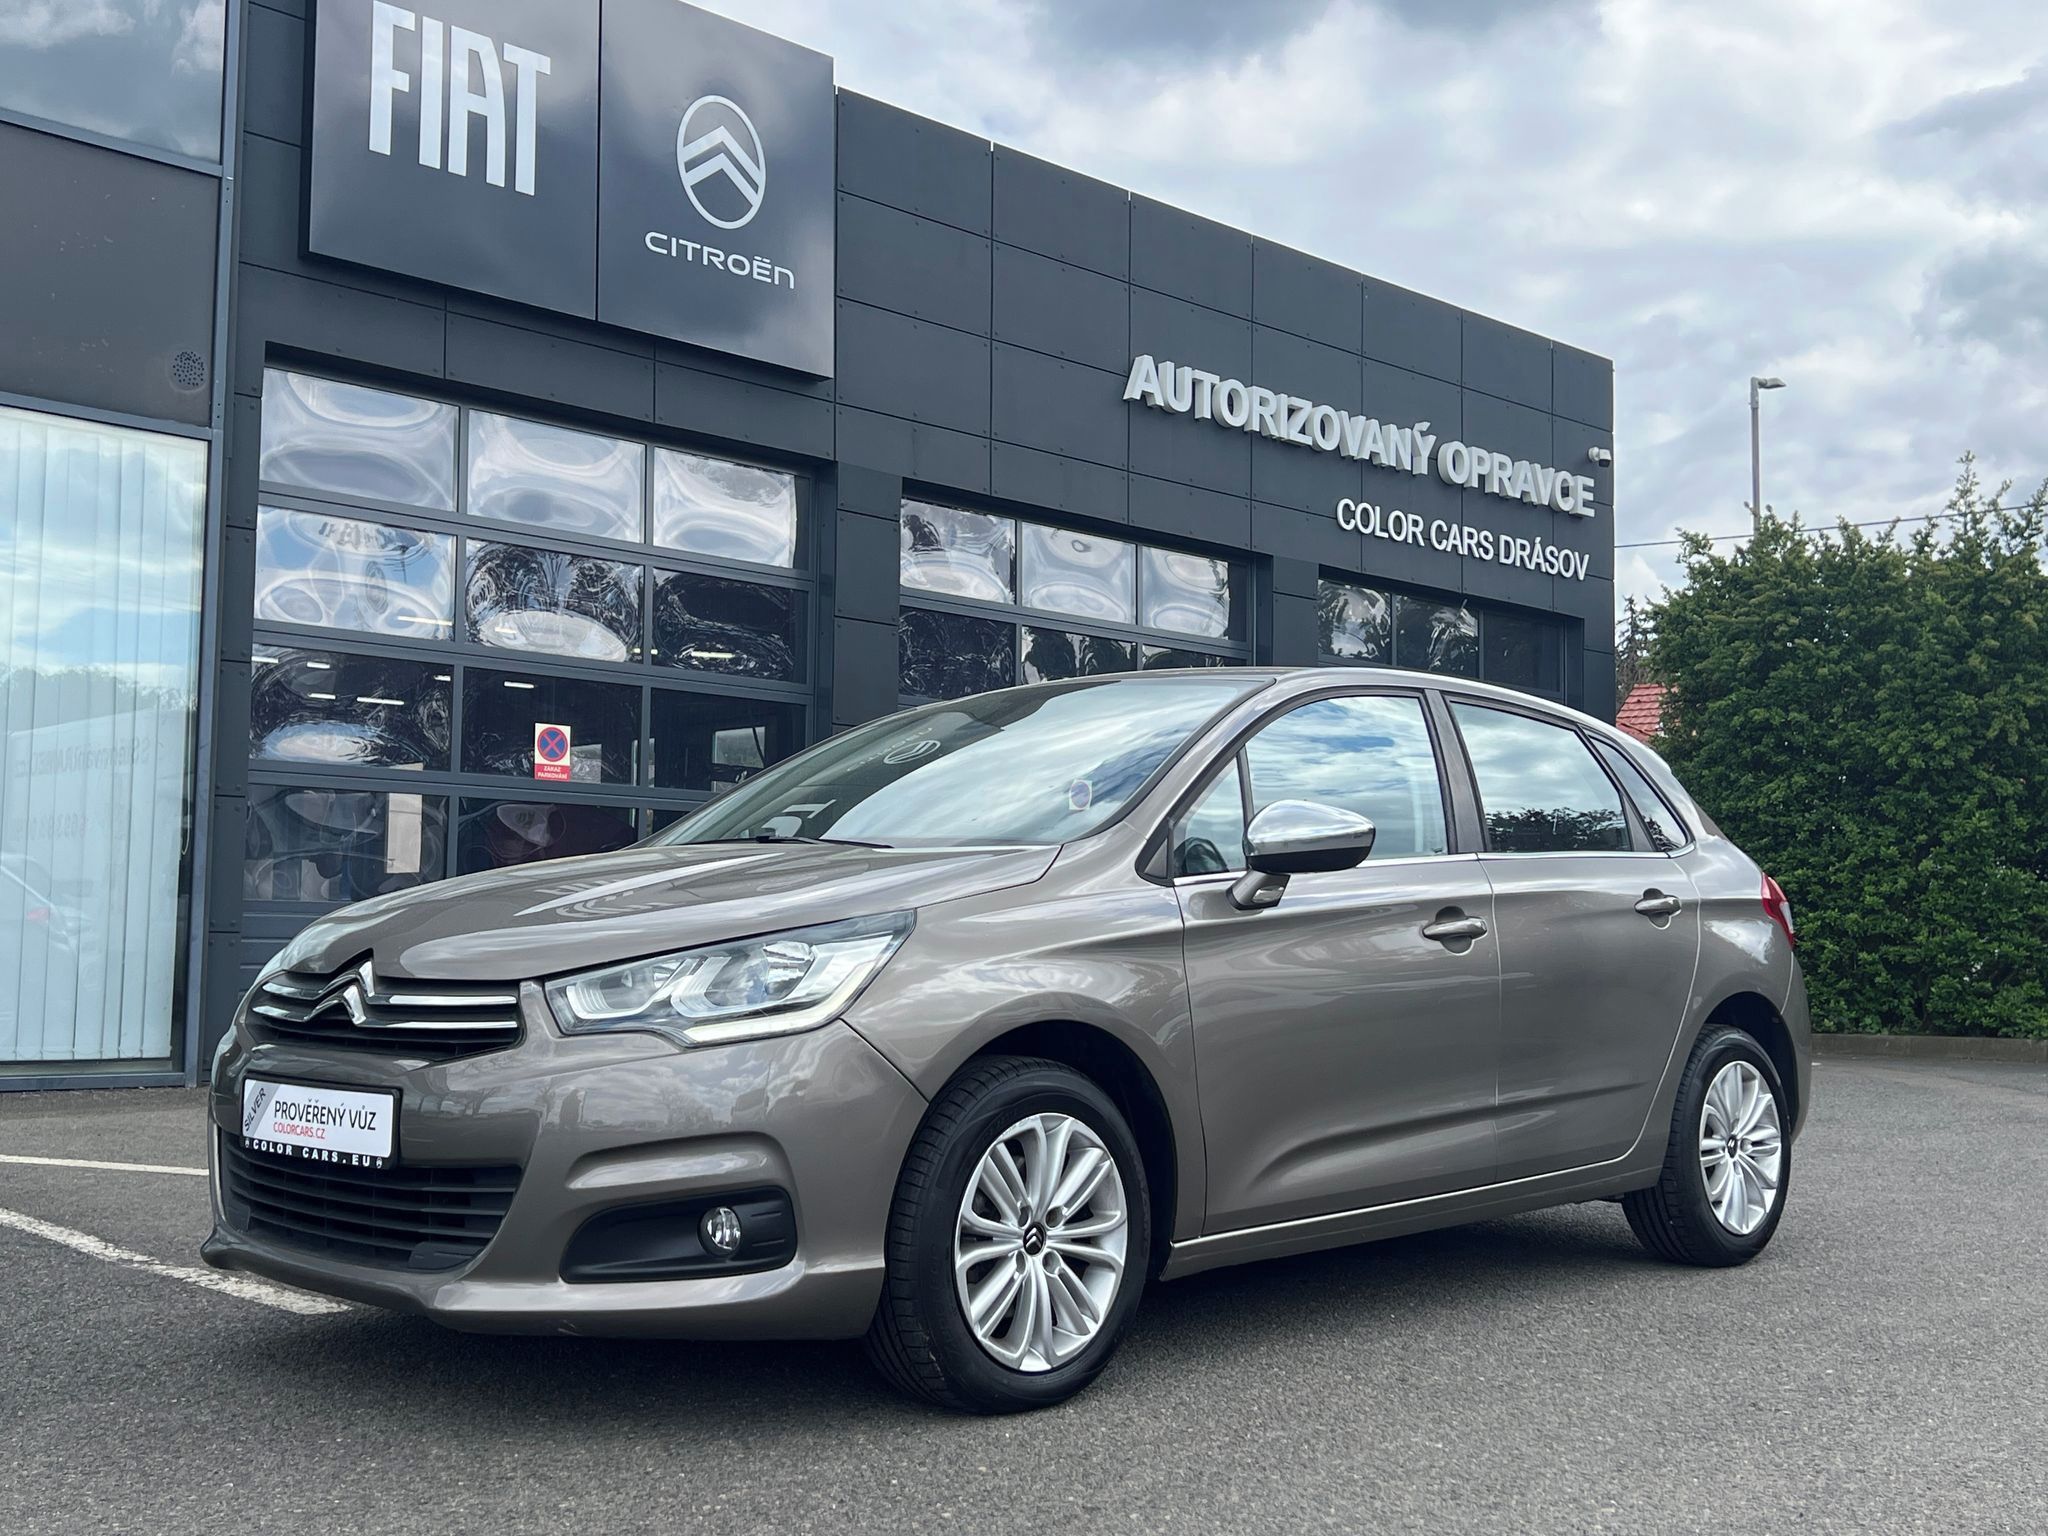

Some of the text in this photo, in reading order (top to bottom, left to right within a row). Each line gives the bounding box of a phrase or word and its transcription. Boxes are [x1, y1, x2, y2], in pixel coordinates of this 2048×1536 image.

[369, 0, 551, 196] FIAT
[644, 231, 795, 289] CITROËN
[1123, 354, 1596, 518] AUTORIZOVANÝ OPRAVCE
[1336, 498, 1590, 582] COLOR CARS DRÁSOV
[244, 1088, 266, 1131] SILVER
[273, 1122, 325, 1139] COLORCARS.CZ
[274, 1098, 376, 1130] PROVĚŘENÝ VŮZ
[252, 1139, 293, 1156] COLOR
